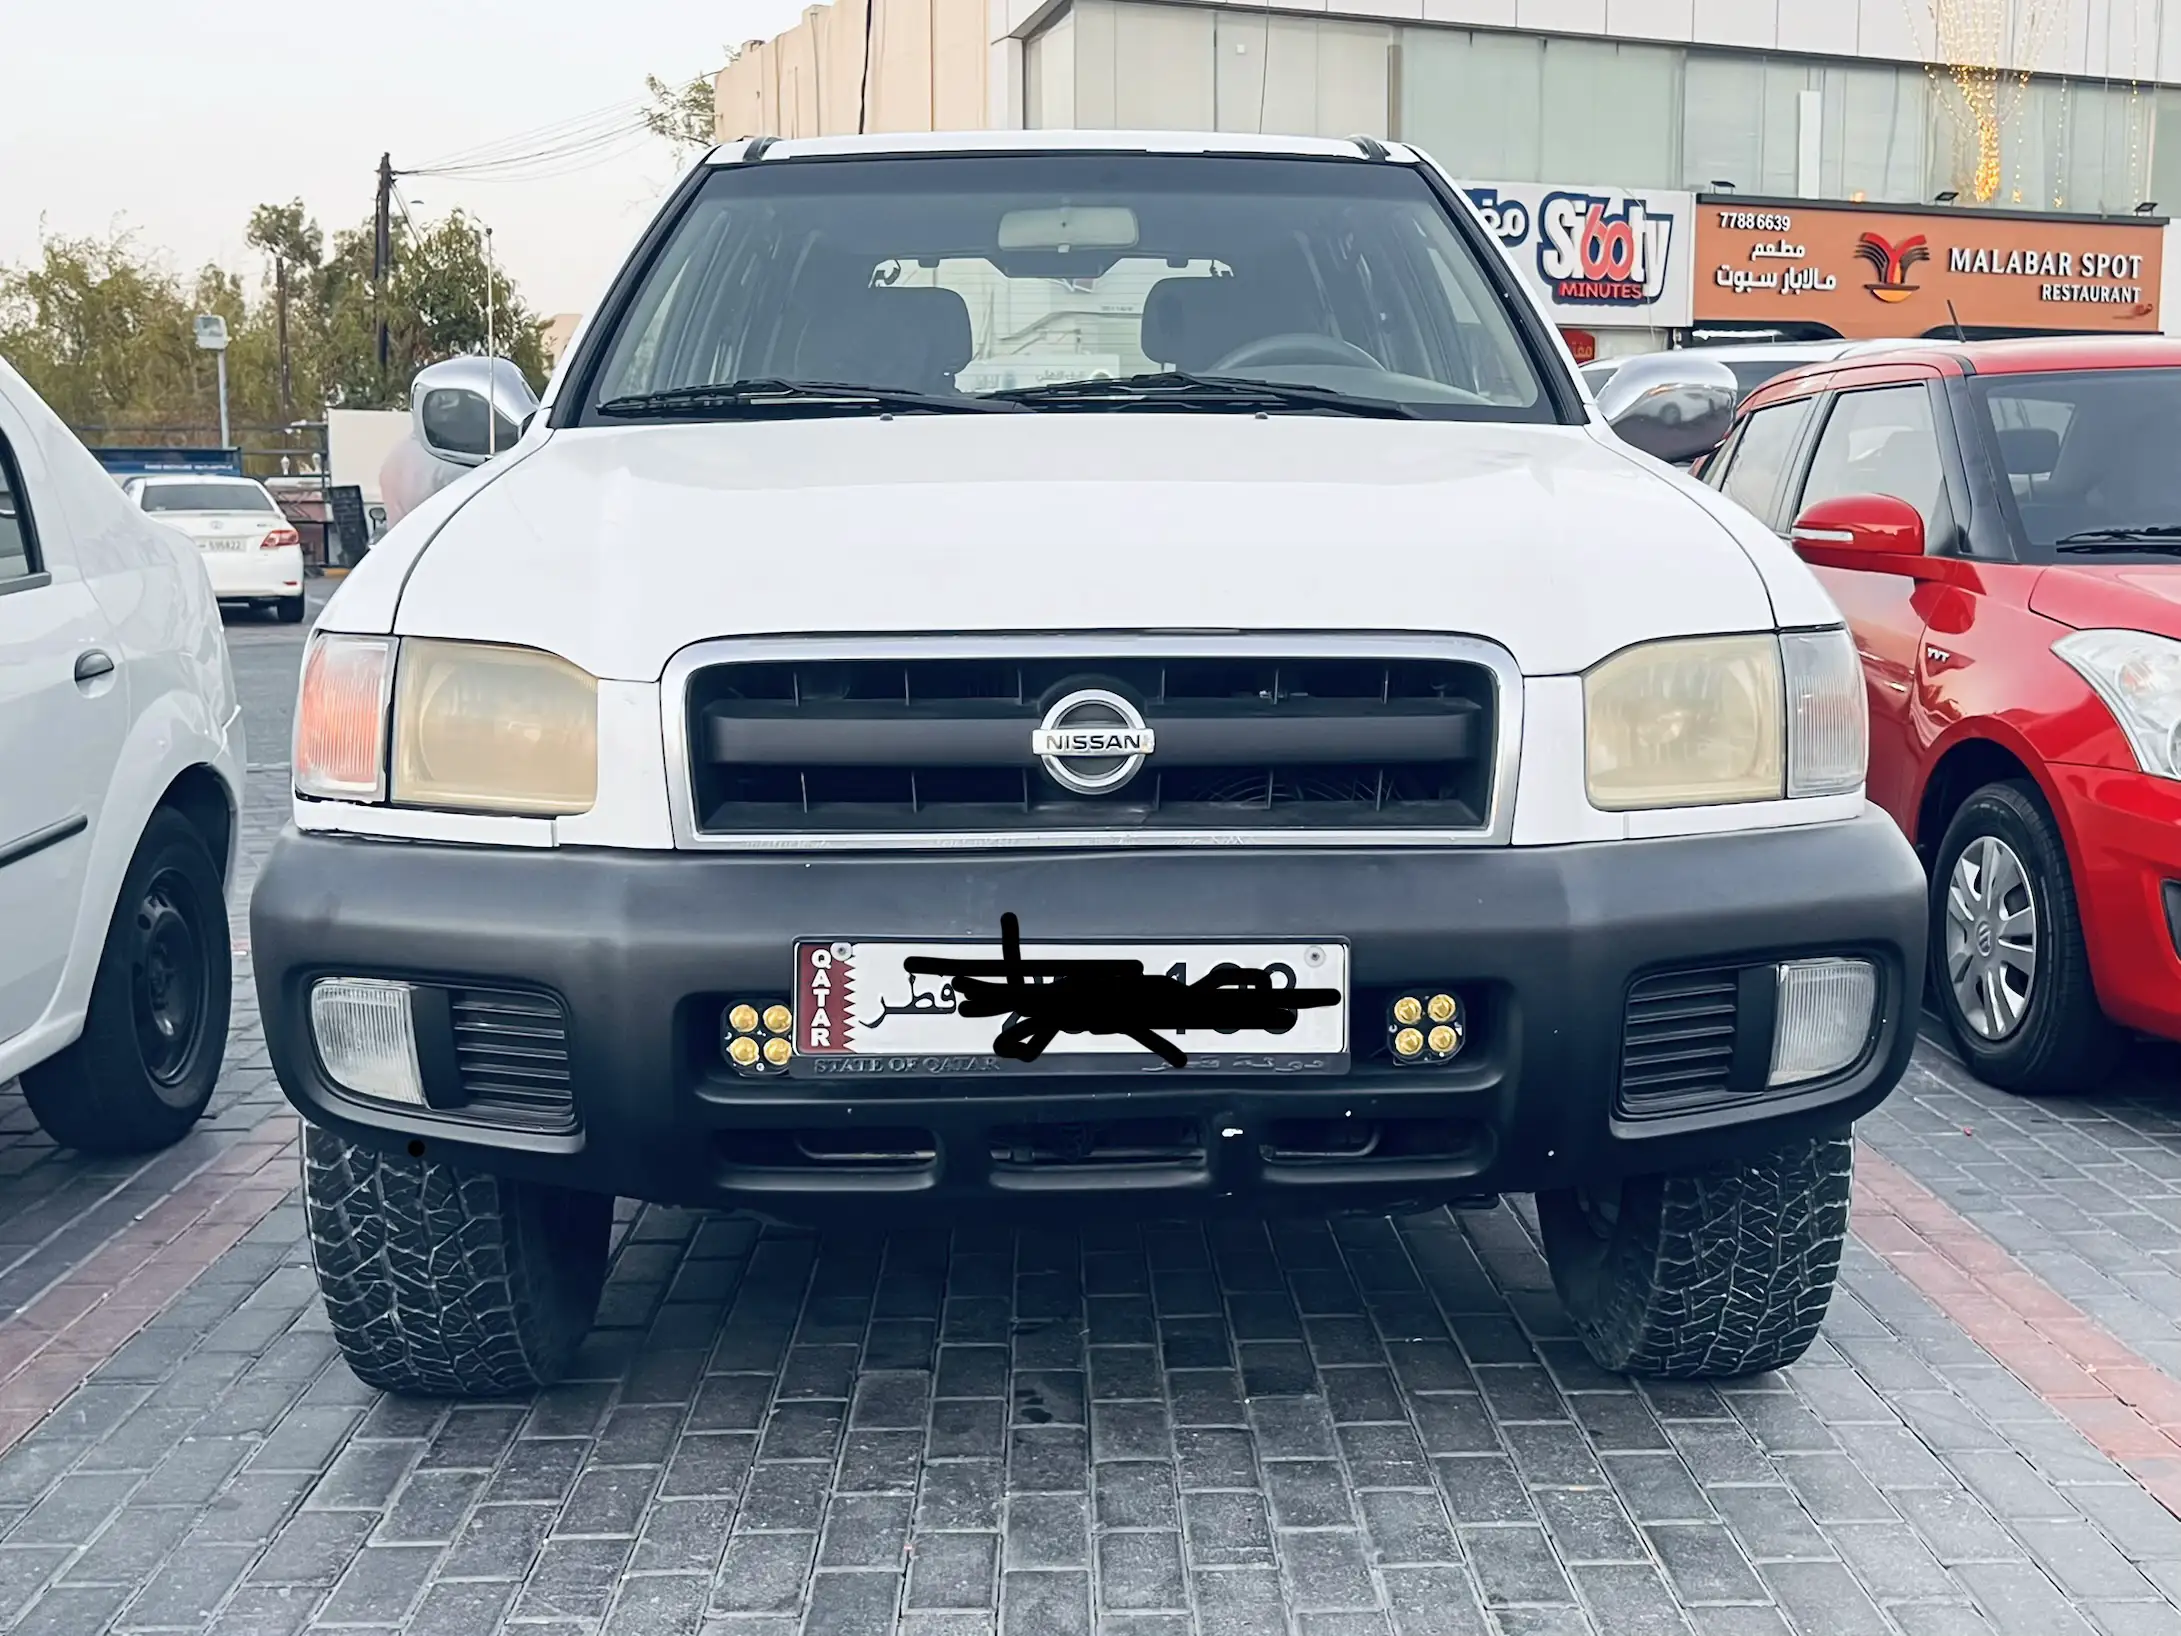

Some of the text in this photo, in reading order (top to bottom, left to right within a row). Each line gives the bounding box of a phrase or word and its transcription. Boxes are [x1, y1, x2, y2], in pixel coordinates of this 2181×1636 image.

[1751, 238, 1806, 261] مطعم
[1949, 247, 2143, 279] MALABAR SPOT
[1561, 281, 1643, 299] MINUTES
[1715, 264, 1837, 295] مالابار سبوت
[2040, 283, 2142, 303] RESTAURANT
[1045, 734, 1141, 750] NISSAN
[811, 948, 833, 1047] QATAR
[814, 1056, 1001, 1074] STATE OF QATAR
